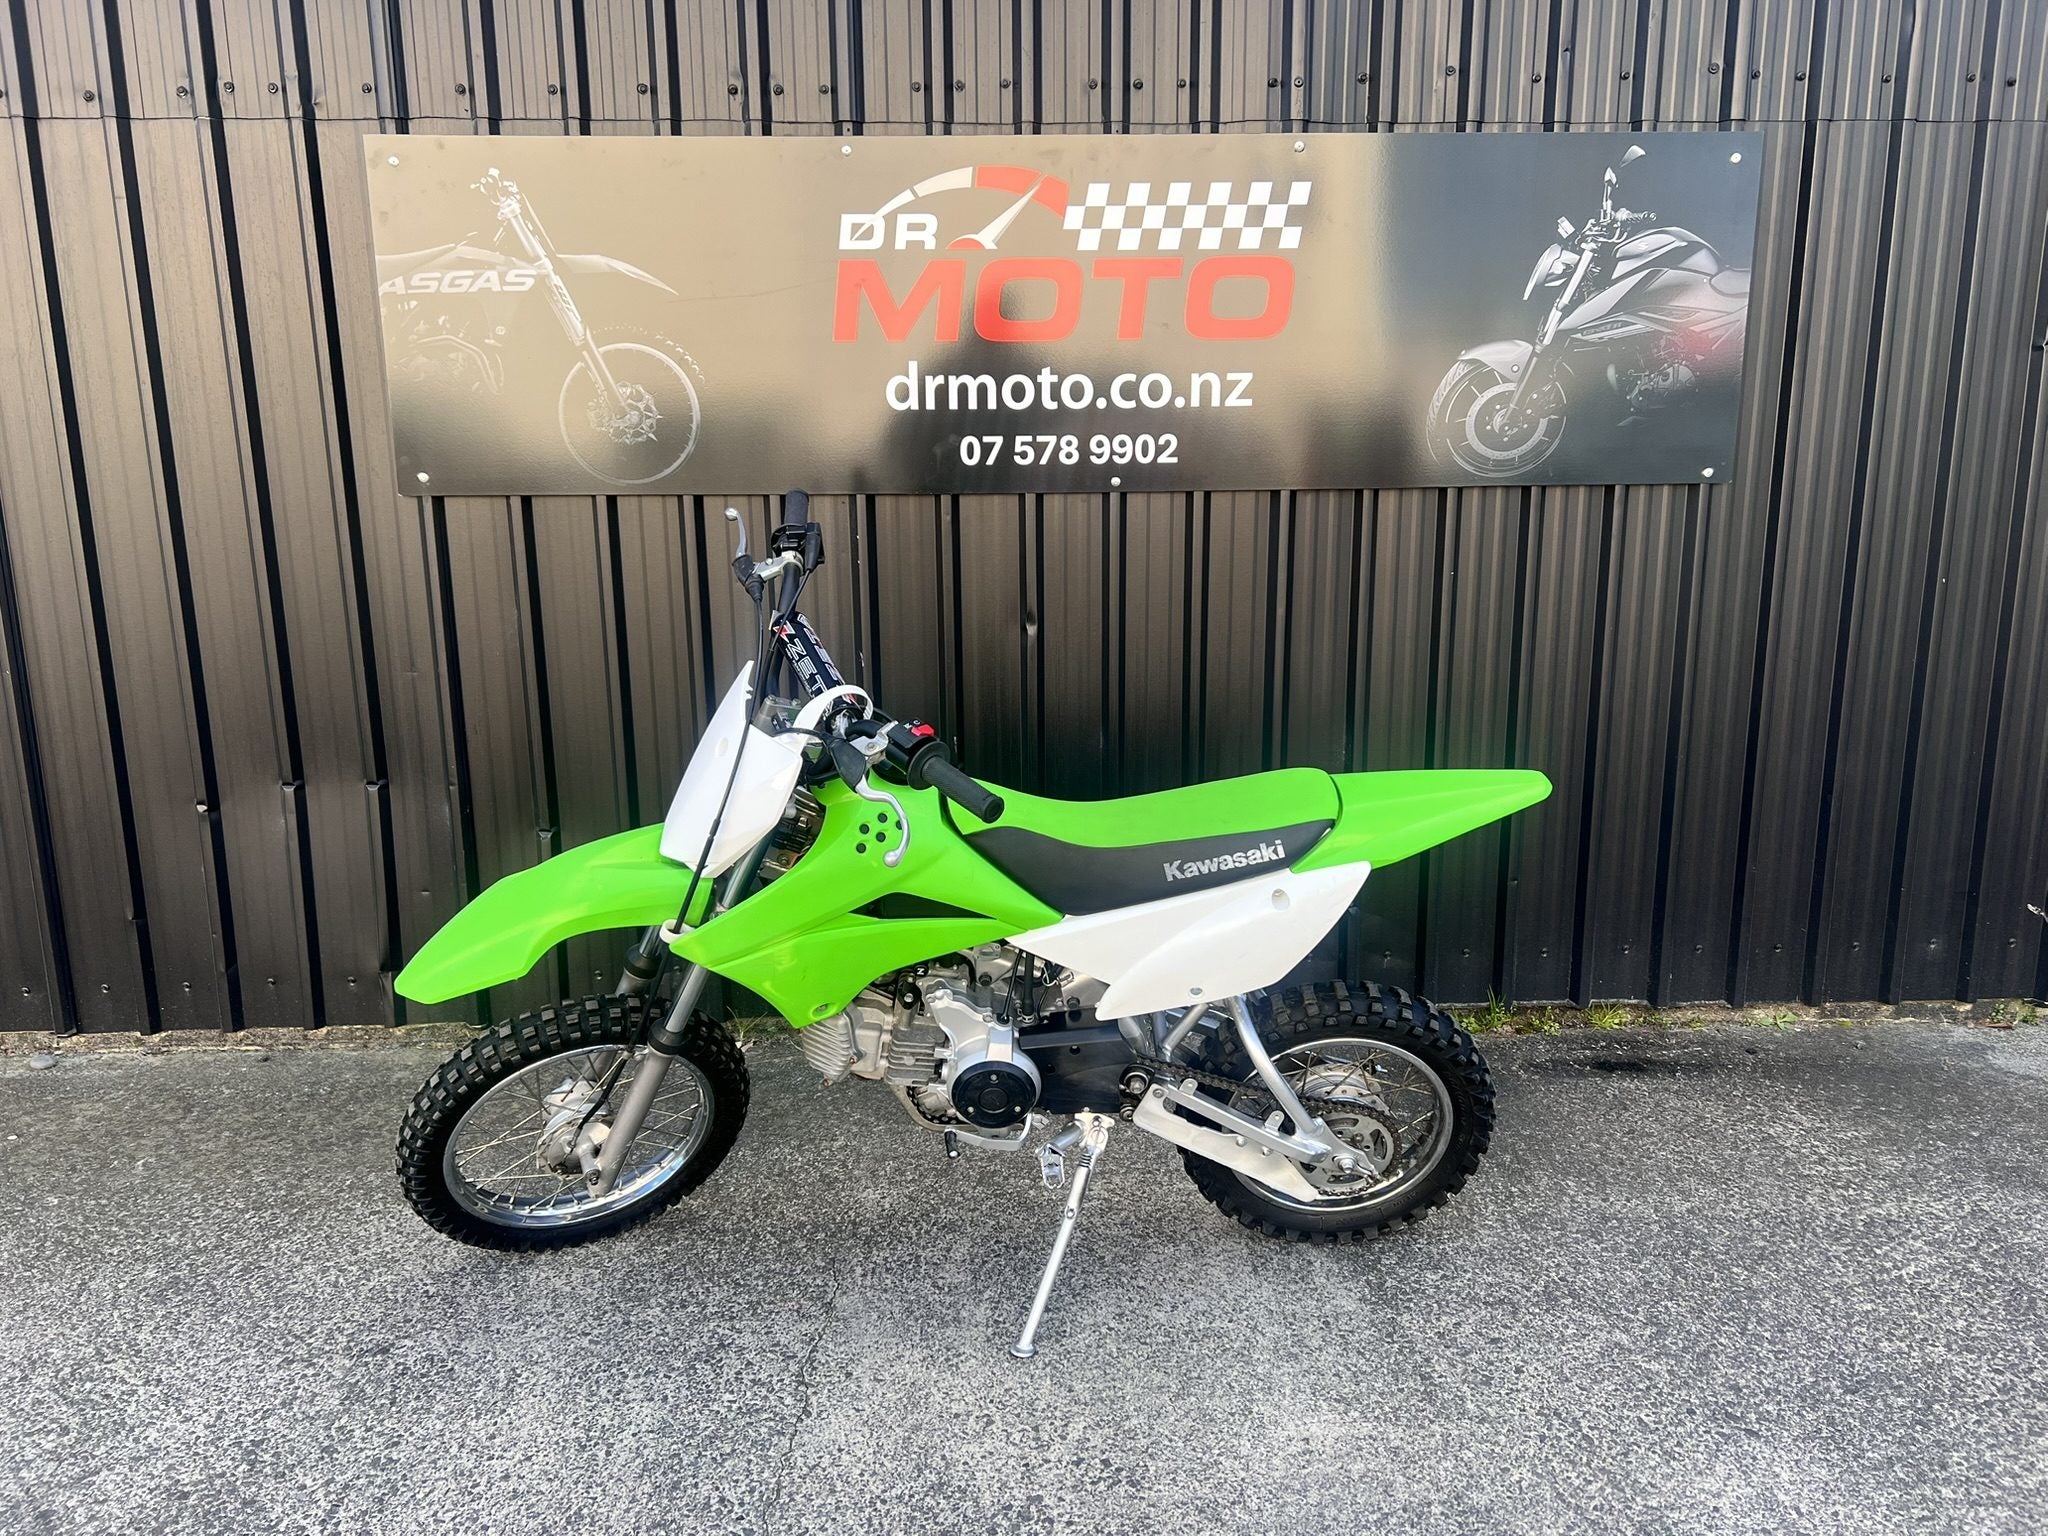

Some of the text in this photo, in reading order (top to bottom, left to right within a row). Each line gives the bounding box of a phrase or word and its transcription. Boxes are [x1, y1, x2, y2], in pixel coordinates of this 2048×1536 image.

[838, 214, 939, 250] DR
[379, 269, 537, 295] ASGAS
[832, 255, 1296, 343] MOTO
[886, 361, 1254, 411] drmoto.co.nz
[959, 433, 1179, 466] 07 578 9902
[1163, 839, 1286, 882] Kawasaki
